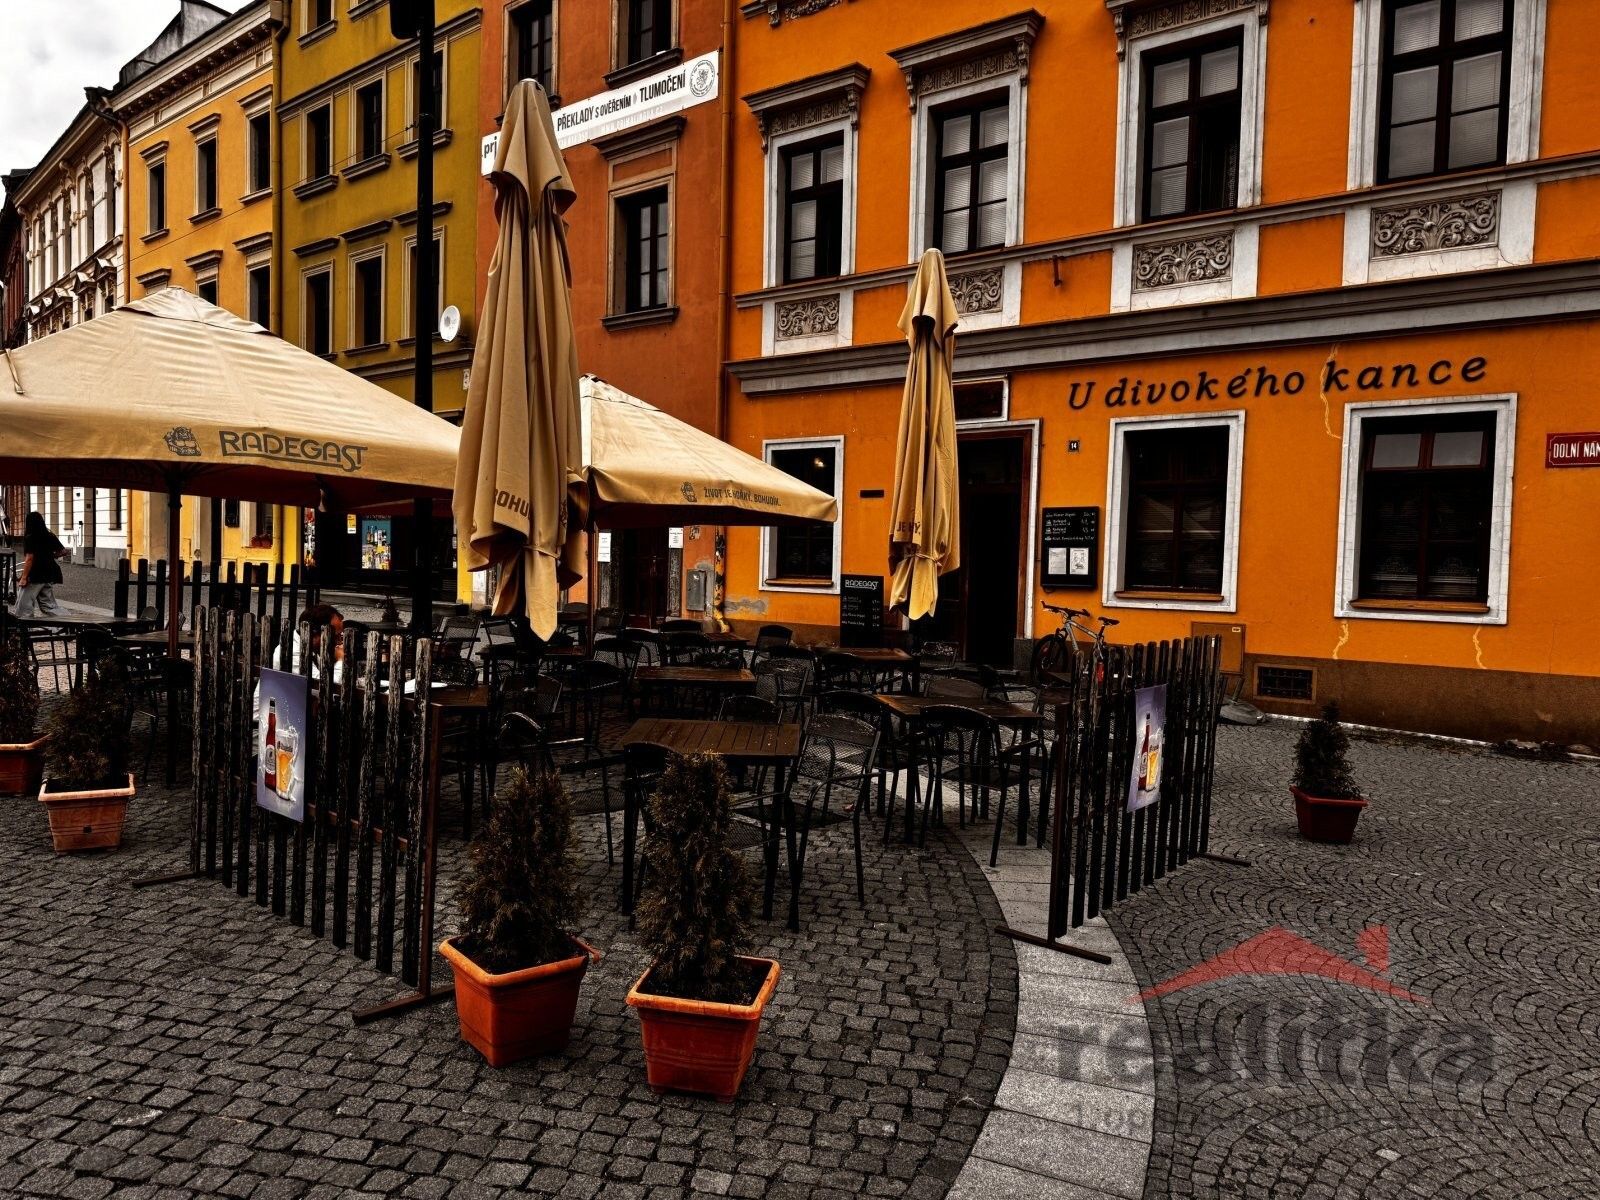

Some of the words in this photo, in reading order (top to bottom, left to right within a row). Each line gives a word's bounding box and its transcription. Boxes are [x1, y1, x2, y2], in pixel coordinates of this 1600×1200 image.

[556, 104, 595, 132] PŘEKLADY
[599, 94, 632, 117] OVĚŘENÍM
[639, 69, 687, 102] TLUMOČENÍ
[1069, 382, 1096, 410] U
[1105, 366, 1305, 408] divokého
[1323, 356, 1488, 393] kance
[218, 430, 368, 473] RADEGAST
[1070, 442, 1077, 450] 14
[1553, 440, 1583, 458] DOLNÍ
[703, 486, 723, 499] ŽIVOT
[844, 579, 880, 591] RADEGAST
